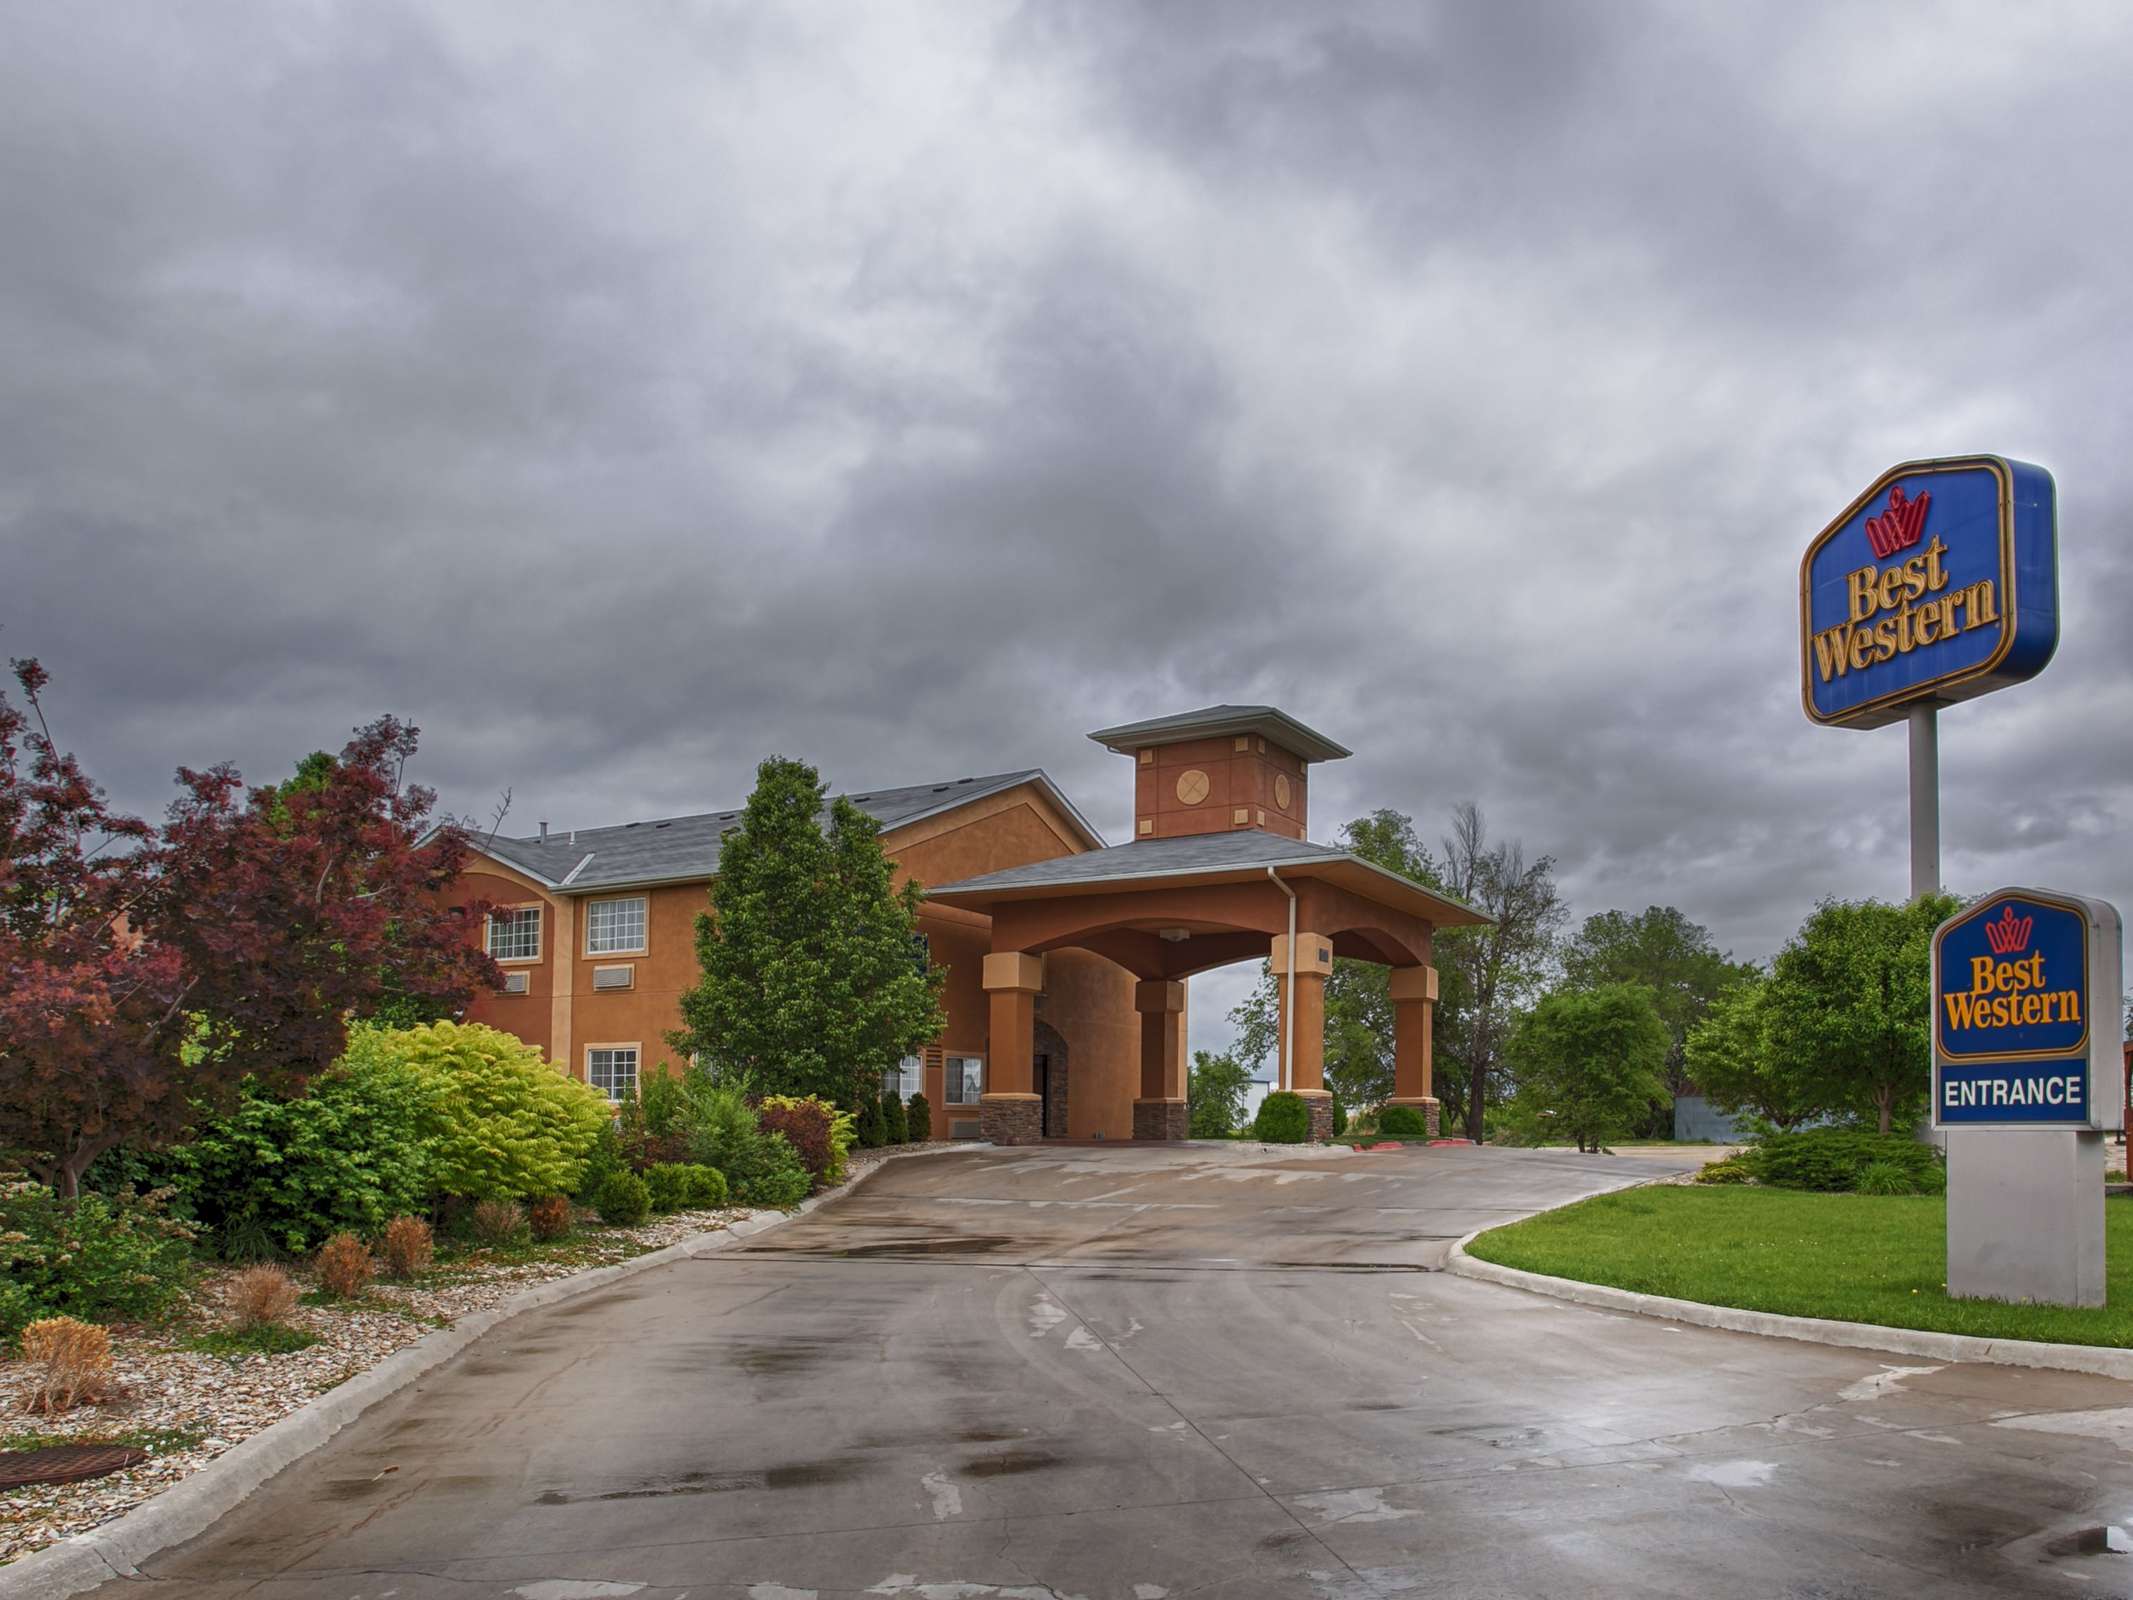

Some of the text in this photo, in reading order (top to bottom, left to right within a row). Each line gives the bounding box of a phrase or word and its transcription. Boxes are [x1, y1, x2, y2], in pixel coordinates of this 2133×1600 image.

[1846, 534, 1948, 625] Best
[1812, 579, 1999, 683] Western
[1970, 950, 2046, 994] Best
[1944, 981, 2081, 1031] Western
[1945, 1076, 2082, 1107] ENTRANCE
